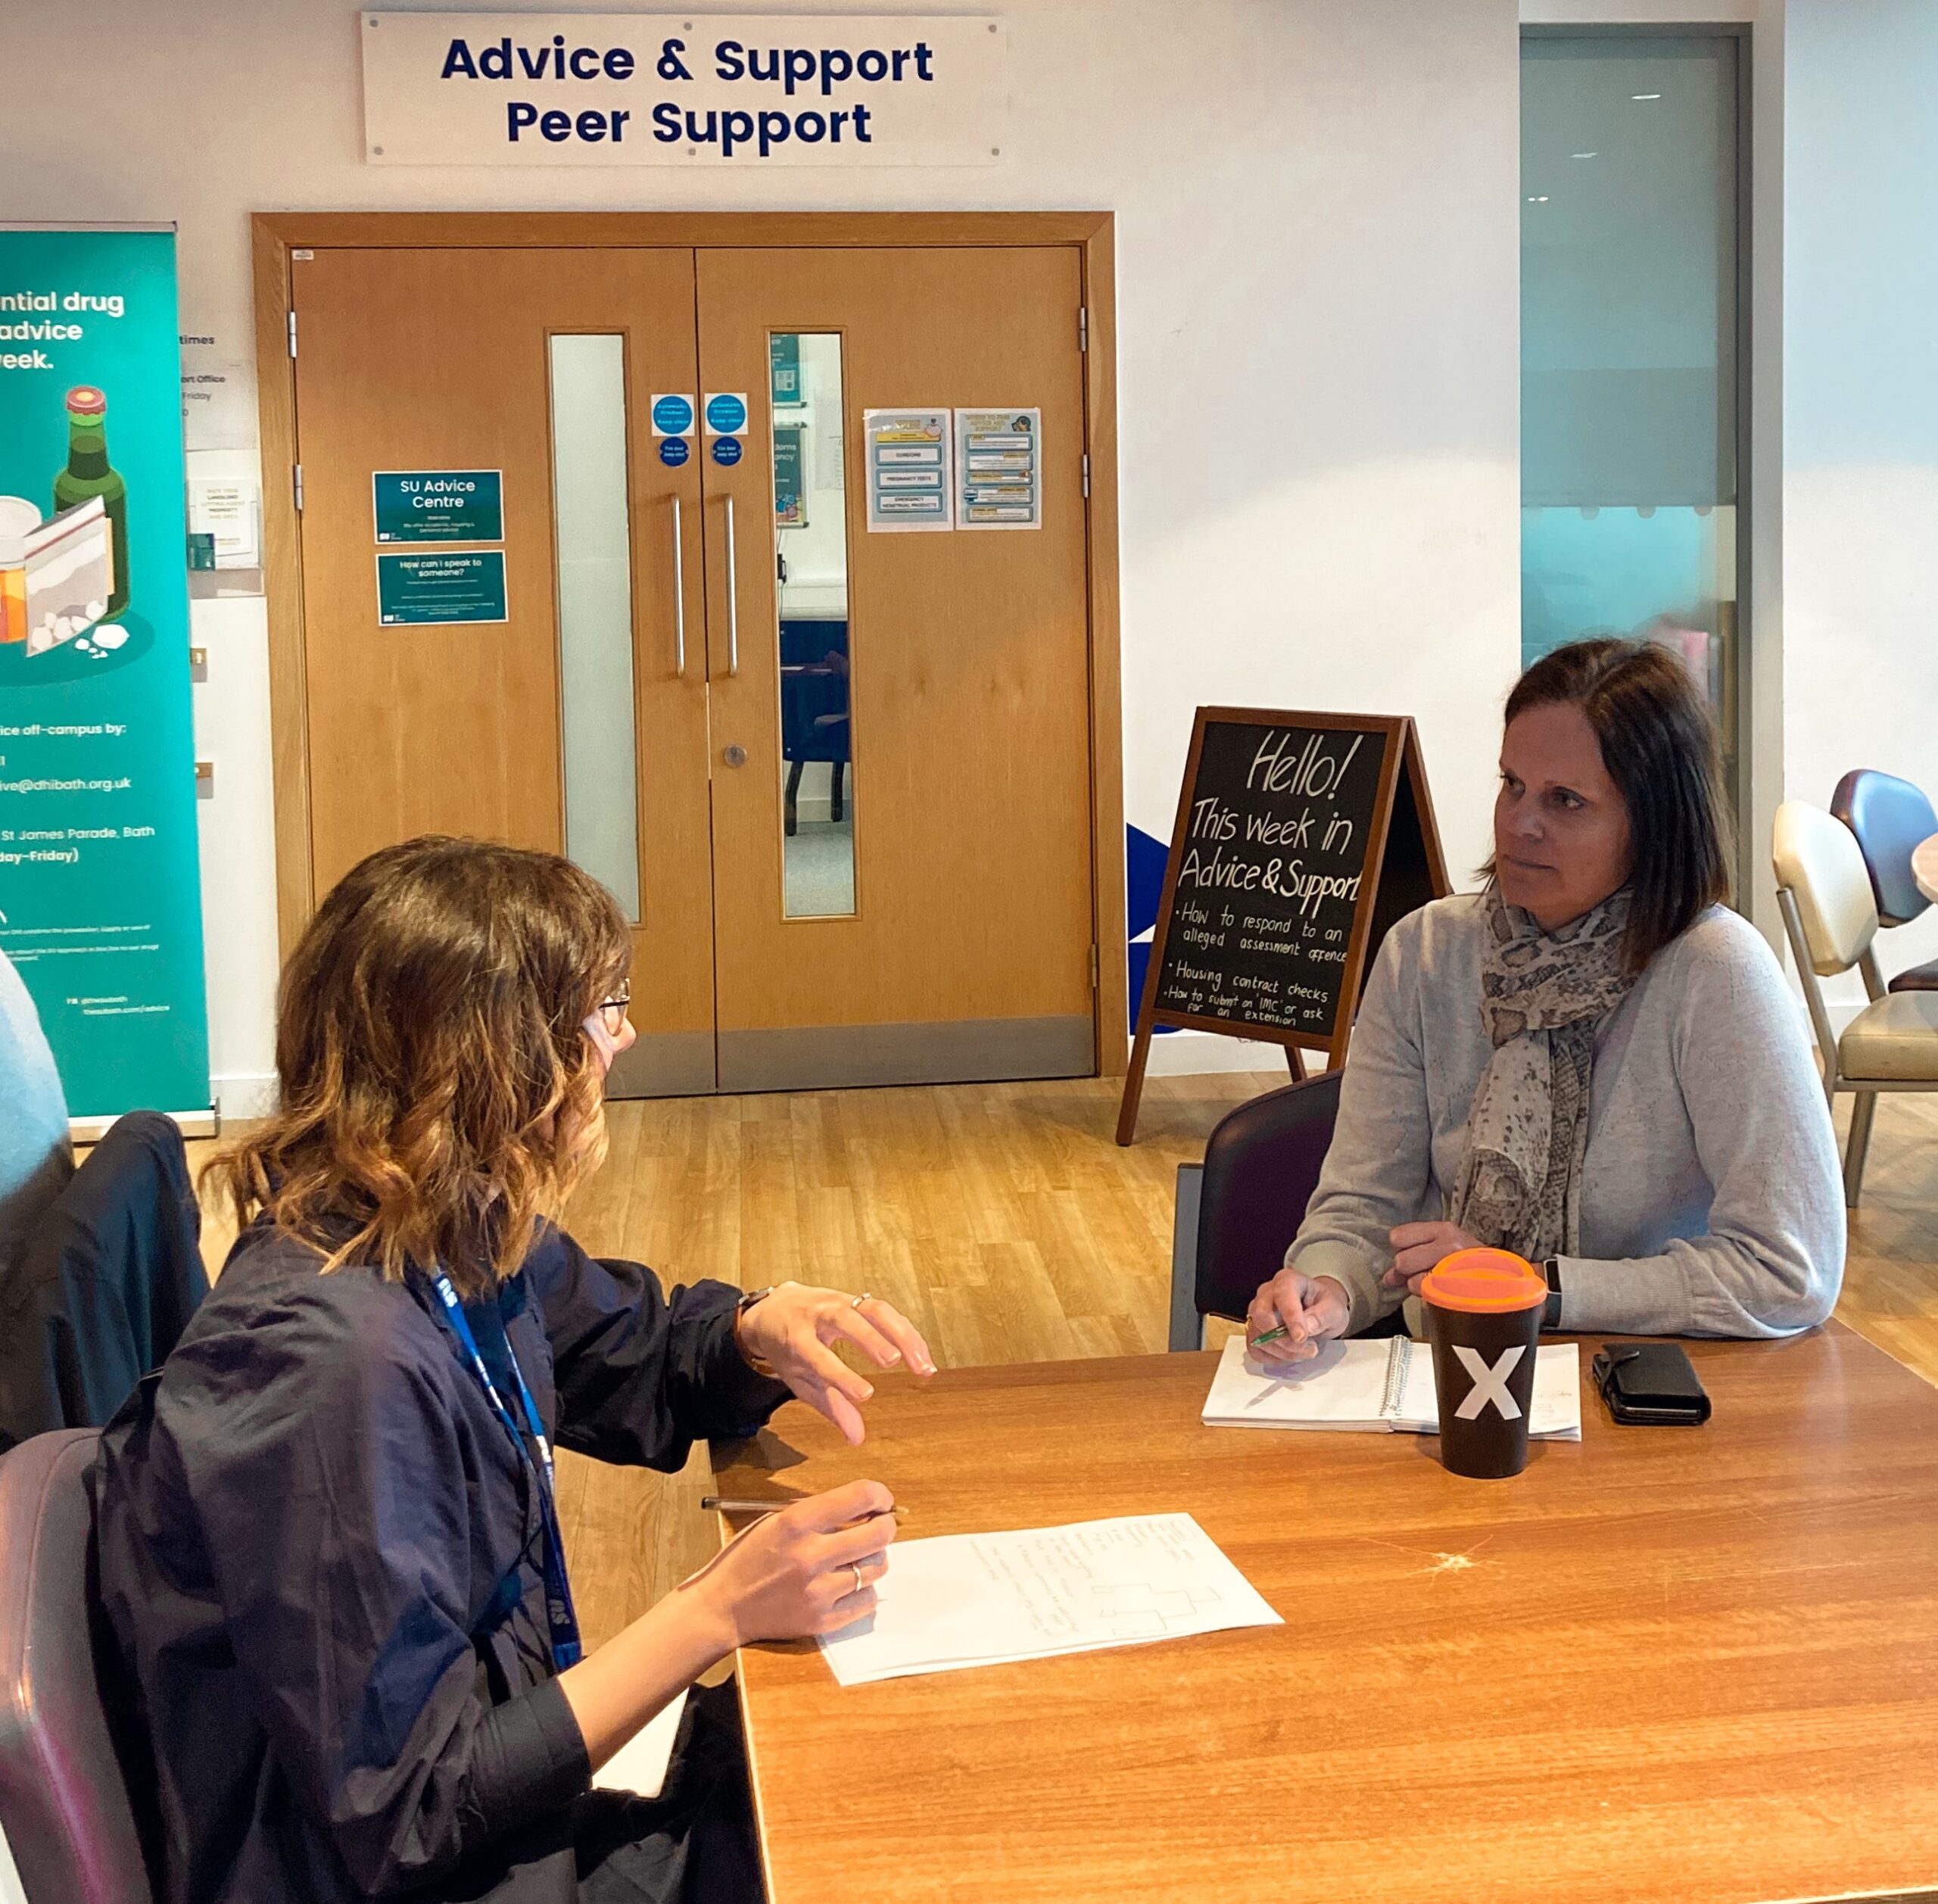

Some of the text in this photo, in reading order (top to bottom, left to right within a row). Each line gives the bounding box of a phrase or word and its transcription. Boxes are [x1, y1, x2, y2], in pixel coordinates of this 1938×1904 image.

[441, 36, 934, 95] Advice & Support
[508, 101, 873, 157] Peer Support
[64, 291, 125, 318] drug
[0, 319, 83, 340] advice
[179, 335, 215, 345] times
[197, 375, 226, 383] Office
[400, 479, 475, 493] SU Advice
[413, 496, 464, 508] Centre
[418, 569, 464, 578] someone?
[444, 559, 471, 569] speak
[472, 559, 482, 567] to
[23, 724, 102, 737] off-campus
[105, 724, 126, 737] by:
[1246, 729, 1364, 800] Hello!
[2, 830, 14, 841] St
[19, 830, 64, 840] James
[123, 826, 155, 837] Bath
[1192, 797, 1239, 840] This
[1321, 812, 1353, 855] in
[1181, 899, 1342, 942] How to respond to an
[1182, 927, 1226, 951] alleged
[1240, 938, 1301, 956] assessment
[1176, 959, 1329, 1003] Housing contract checks
[1168, 985, 1188, 999] How
[1192, 987, 1203, 1002] to
[1285, 1005, 1298, 1014] or
[1303, 1007, 1323, 1021] ask
[1217, 1007, 1230, 1017] an
[1245, 1010, 1296, 1027] extension
[1451, 1345, 1527, 1420] X
